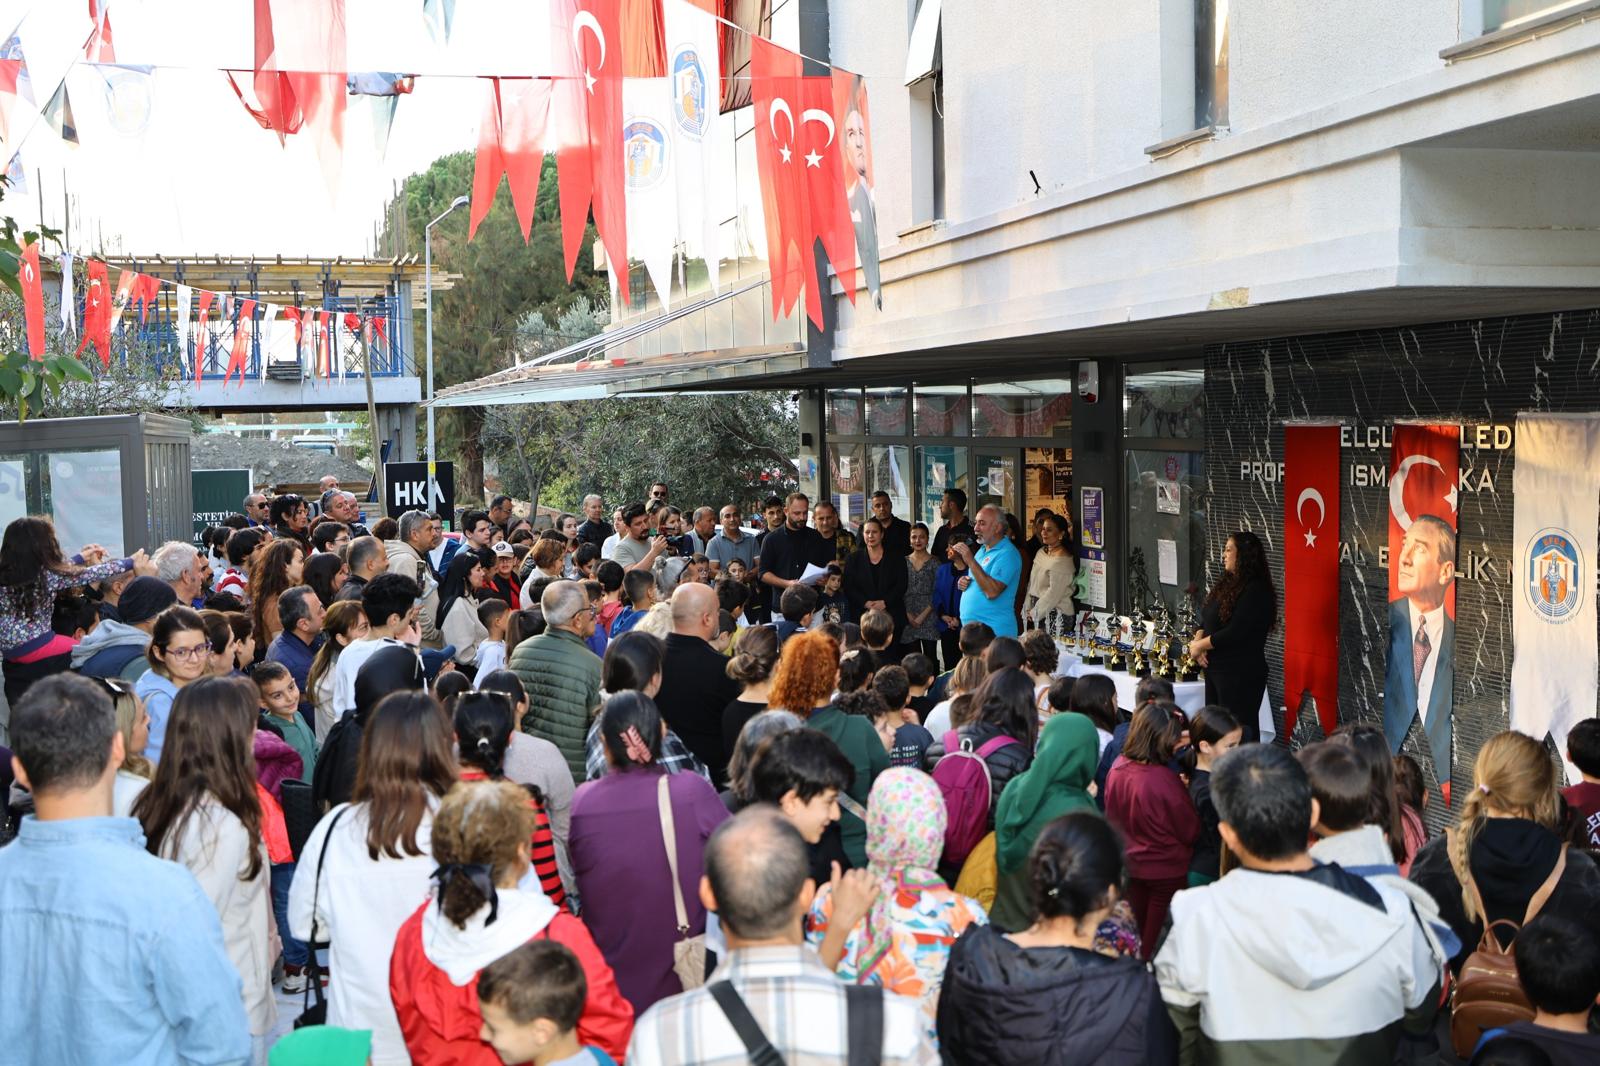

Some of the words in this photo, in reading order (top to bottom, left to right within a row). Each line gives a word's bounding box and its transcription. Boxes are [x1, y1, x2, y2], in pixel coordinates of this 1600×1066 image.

[1350, 464, 1391, 488] ISM
[1339, 541, 1367, 566] AL
[1455, 550, 1491, 581] İK
